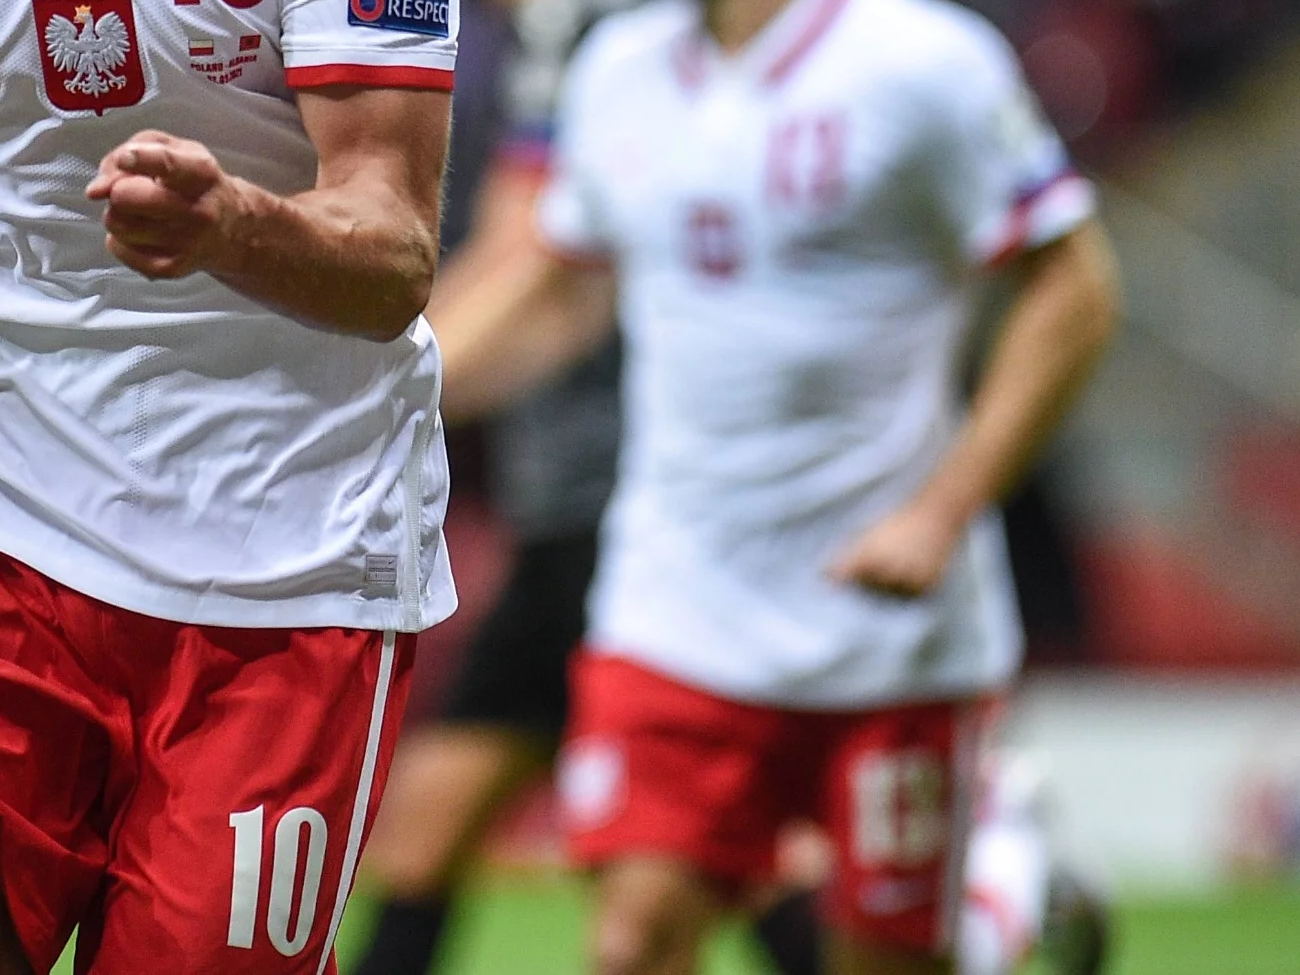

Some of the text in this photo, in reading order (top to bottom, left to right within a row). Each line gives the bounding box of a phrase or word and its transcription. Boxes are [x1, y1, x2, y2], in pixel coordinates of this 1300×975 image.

[190, 62, 223, 73] POLAND
[229, 54, 257, 67] ALBANIA
[227, 803, 328, 957] 10
